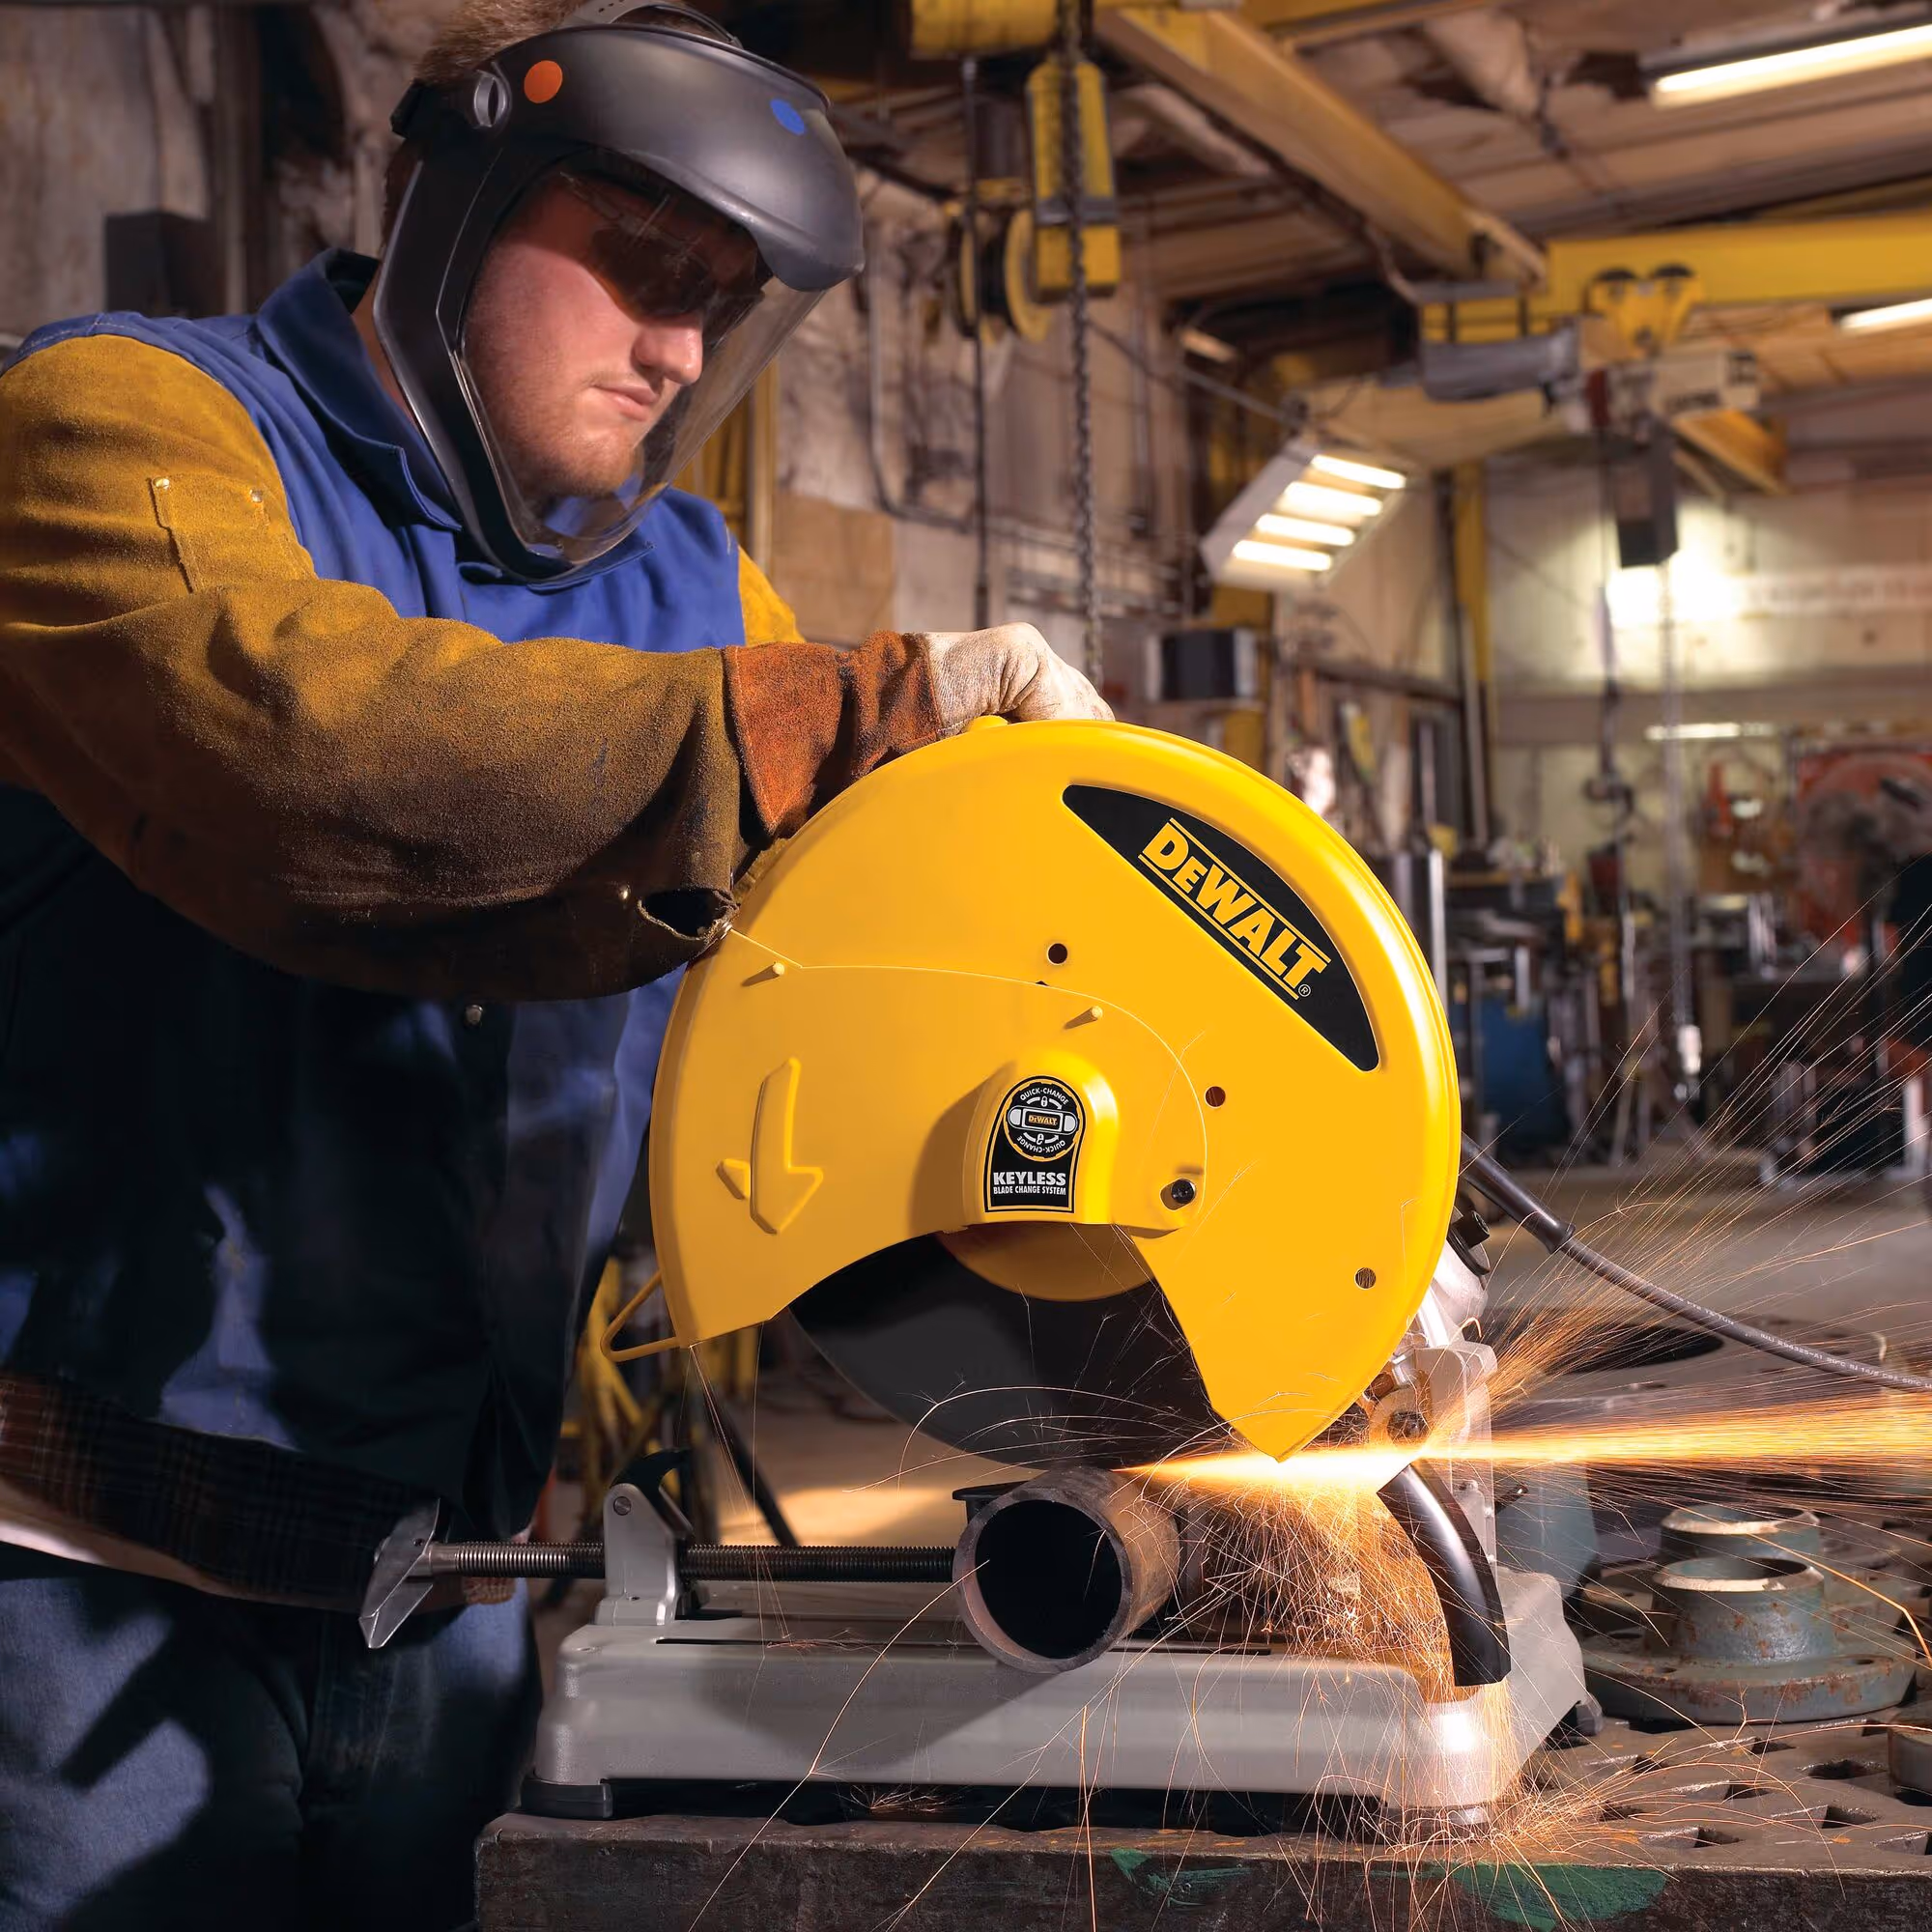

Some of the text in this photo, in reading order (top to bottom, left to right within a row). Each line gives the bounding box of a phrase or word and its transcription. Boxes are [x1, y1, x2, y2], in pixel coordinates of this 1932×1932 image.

[1020, 1088, 1069, 1105] QUICK-CHANGE
[1016, 1135, 1066, 1153] QUICK-CHANGE
[993, 1171, 1066, 1186] KEYLESS
[993, 1185, 1066, 1196] BLADE CHANGE SYSTEM
